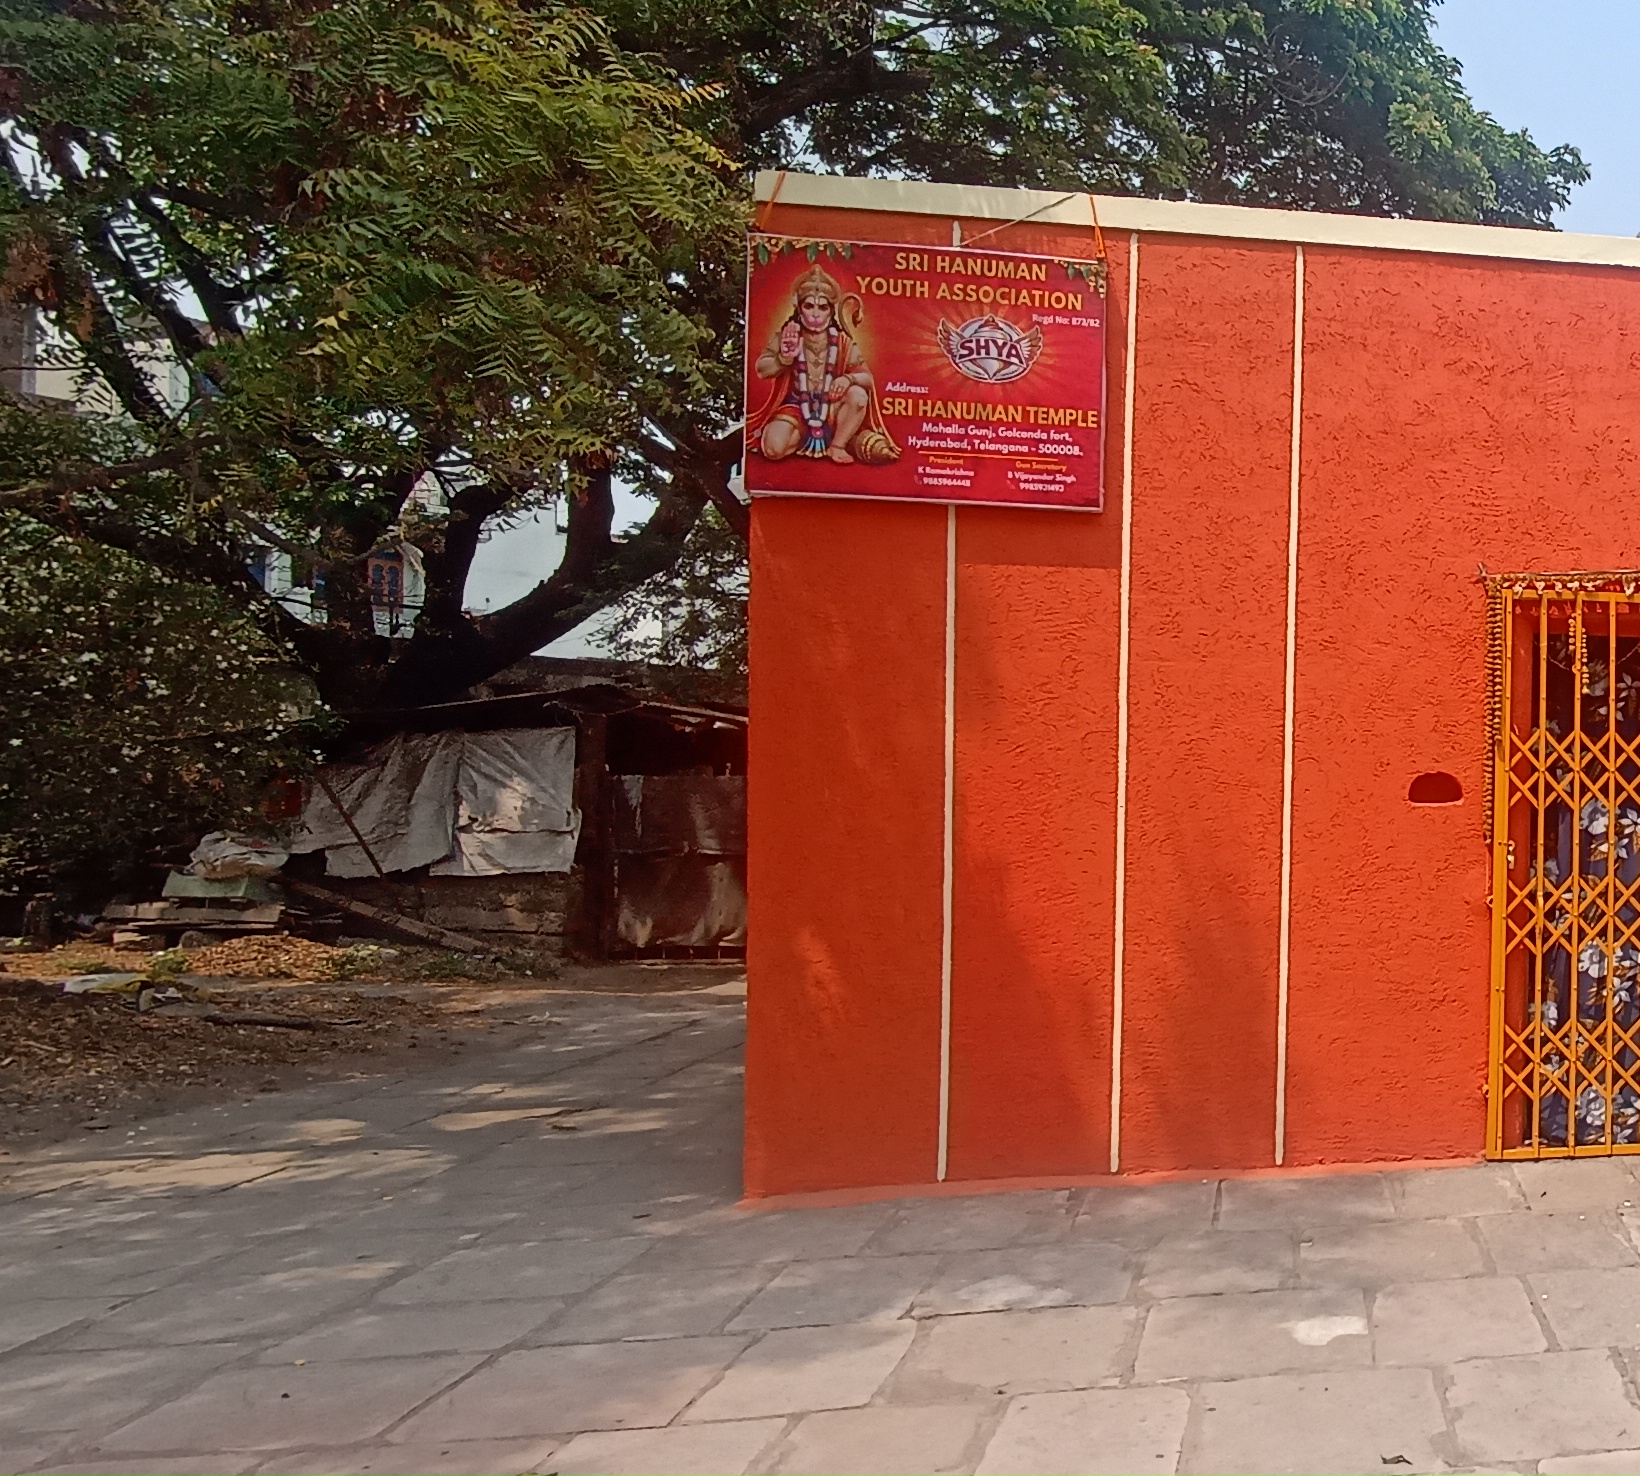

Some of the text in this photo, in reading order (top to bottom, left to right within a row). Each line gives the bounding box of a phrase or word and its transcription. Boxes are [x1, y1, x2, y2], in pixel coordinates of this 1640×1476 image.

[895, 252, 1046, 281] SRI HANUMAN
[856, 276, 1082, 310] YOUTH ASSOCIATION
[1032, 314, 1053, 325] Regd
[956, 336, 1026, 367] SHYA
[885, 382, 929, 394] Address:
[882, 397, 1098, 427] SRI HANUMAN TEMPLE
[922, 422, 966, 435] Mohalla
[968, 425, 996, 439] Gunj,
[907, 436, 972, 451] Hyderabad,
[974, 440, 1029, 454] Telangana
